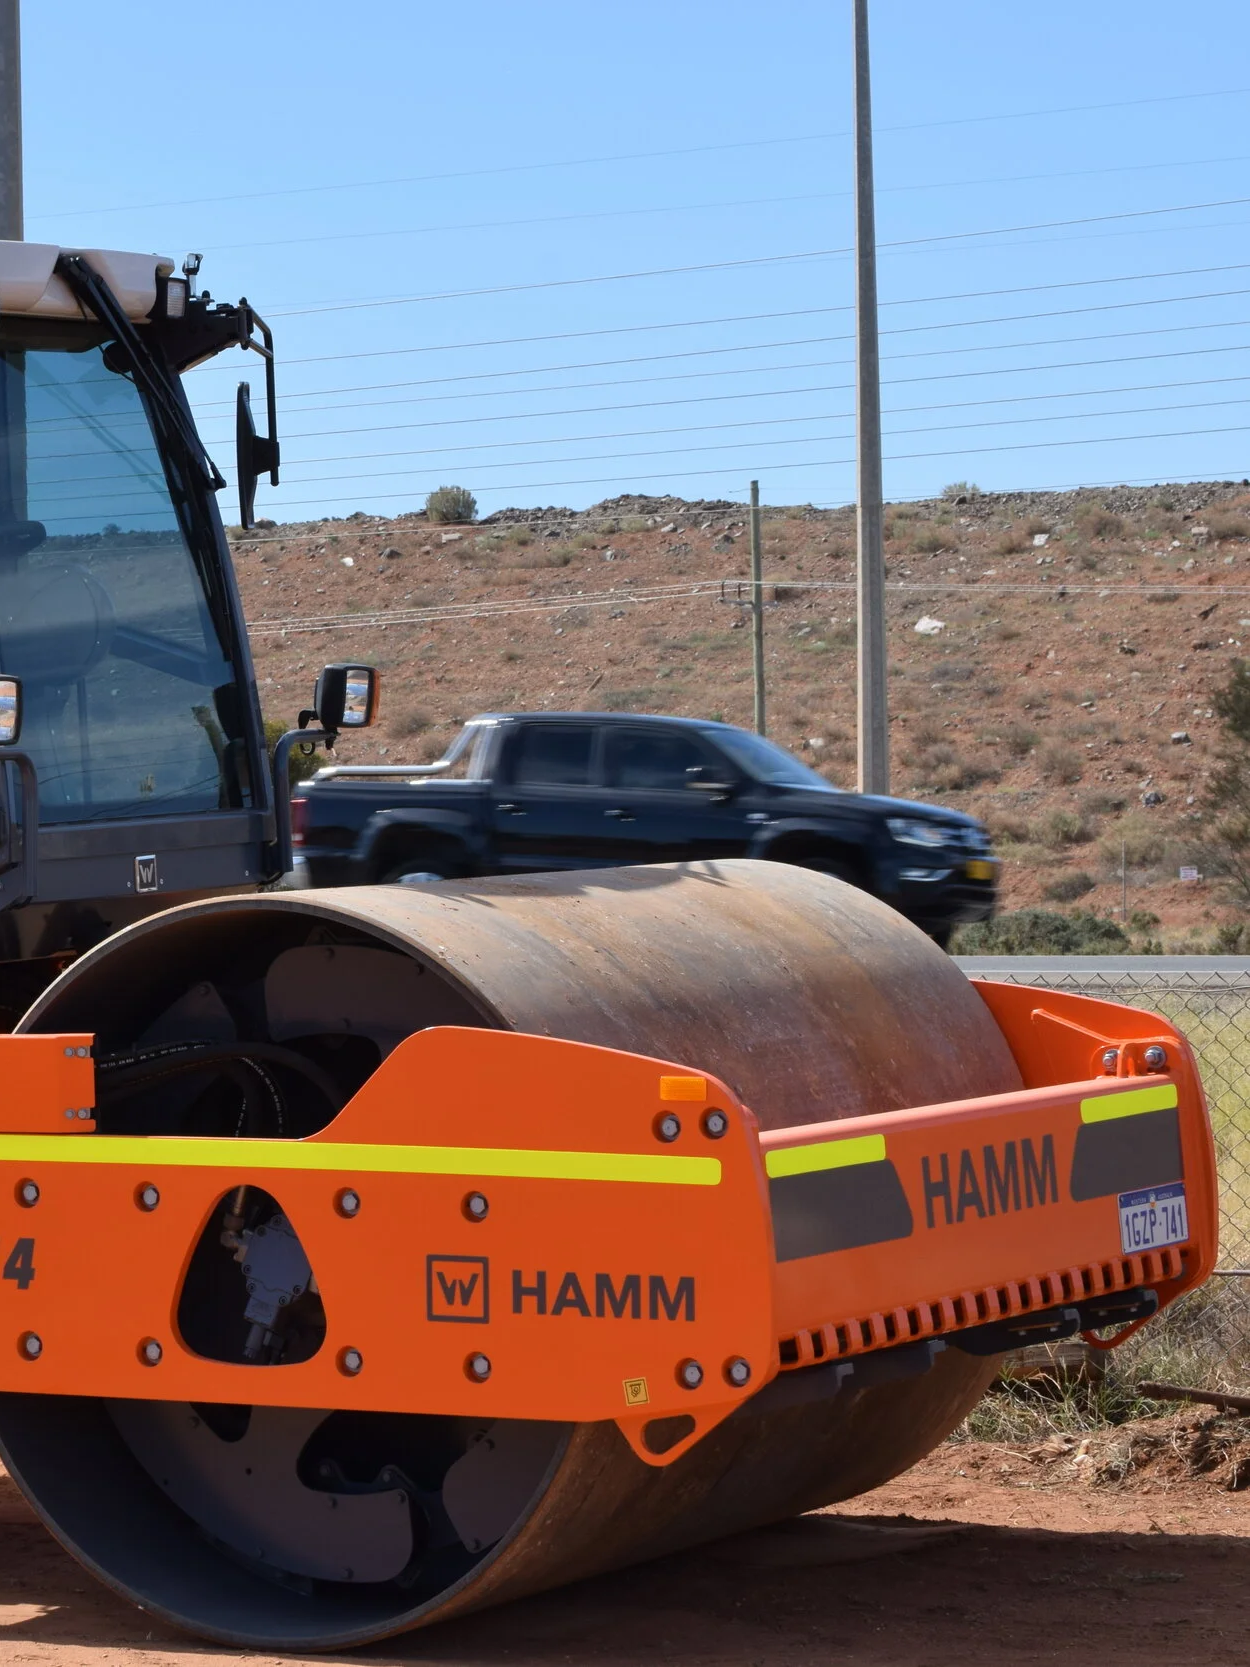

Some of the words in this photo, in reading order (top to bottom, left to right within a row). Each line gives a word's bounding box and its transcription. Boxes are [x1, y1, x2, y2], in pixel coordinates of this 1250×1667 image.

[139, 863, 154, 883] W
[921, 1133, 1059, 1230] HAMM
[512, 1269, 696, 1322] HAMM
